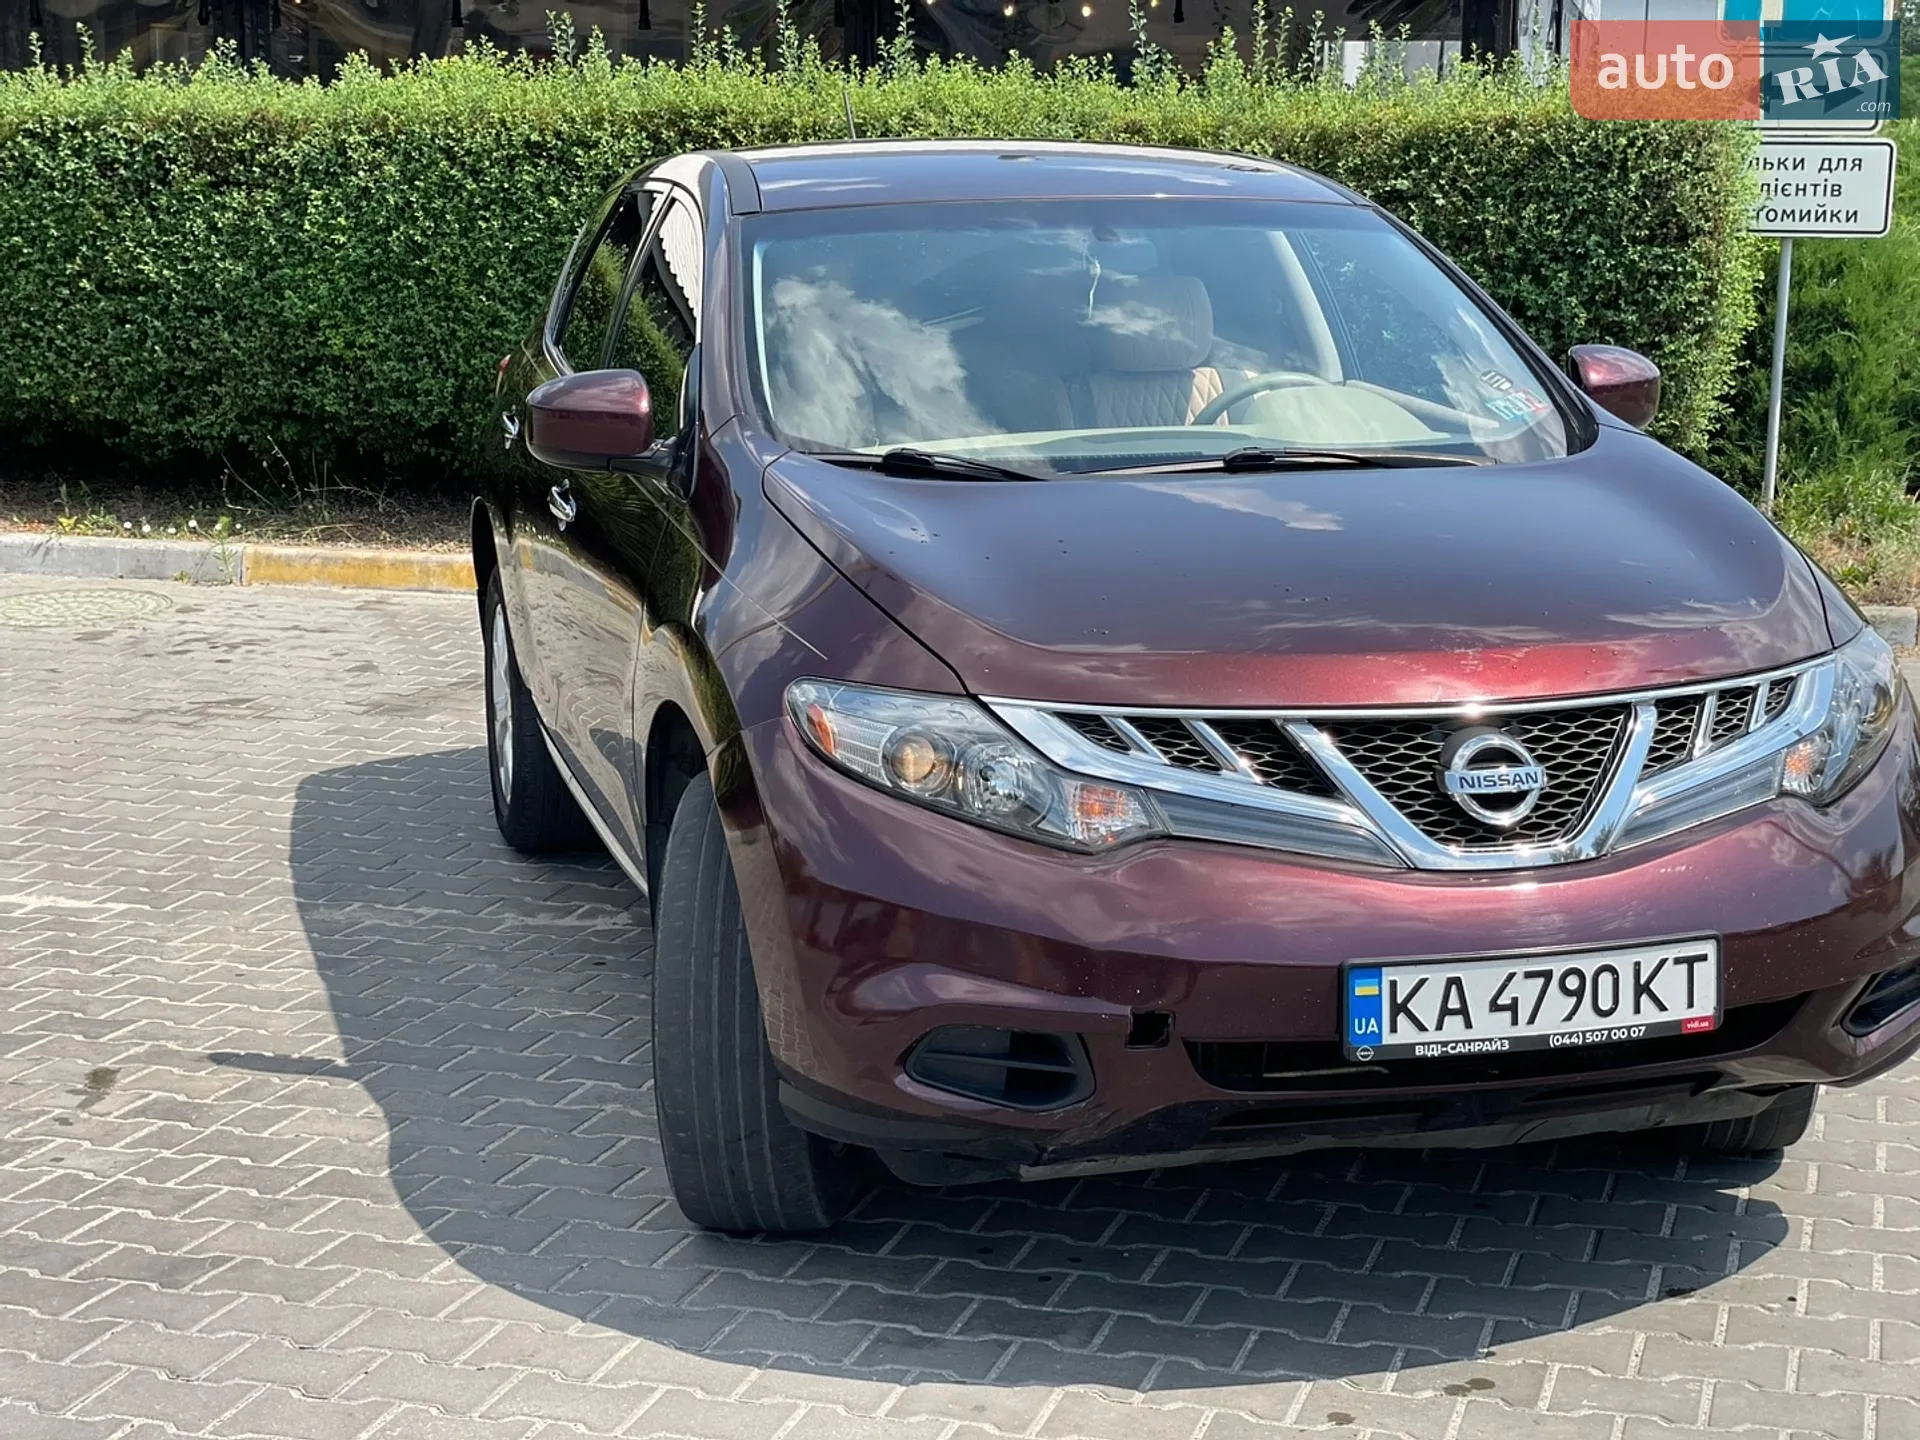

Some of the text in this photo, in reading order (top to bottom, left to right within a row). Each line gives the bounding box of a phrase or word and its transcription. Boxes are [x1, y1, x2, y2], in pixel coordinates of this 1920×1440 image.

[1748, 157, 1863, 173] льки для
[1760, 178, 1842, 197] лієнтів
[1459, 771, 1539, 789] NISSAN
[1388, 953, 1708, 1034] KA 4790 KT
[1354, 1018, 1379, 1035] UA
[1549, 1026, 1646, 1048] (044) 507 00 07
[1415, 1038, 1510, 1057] ВІДІ-САНРАЙЗ
